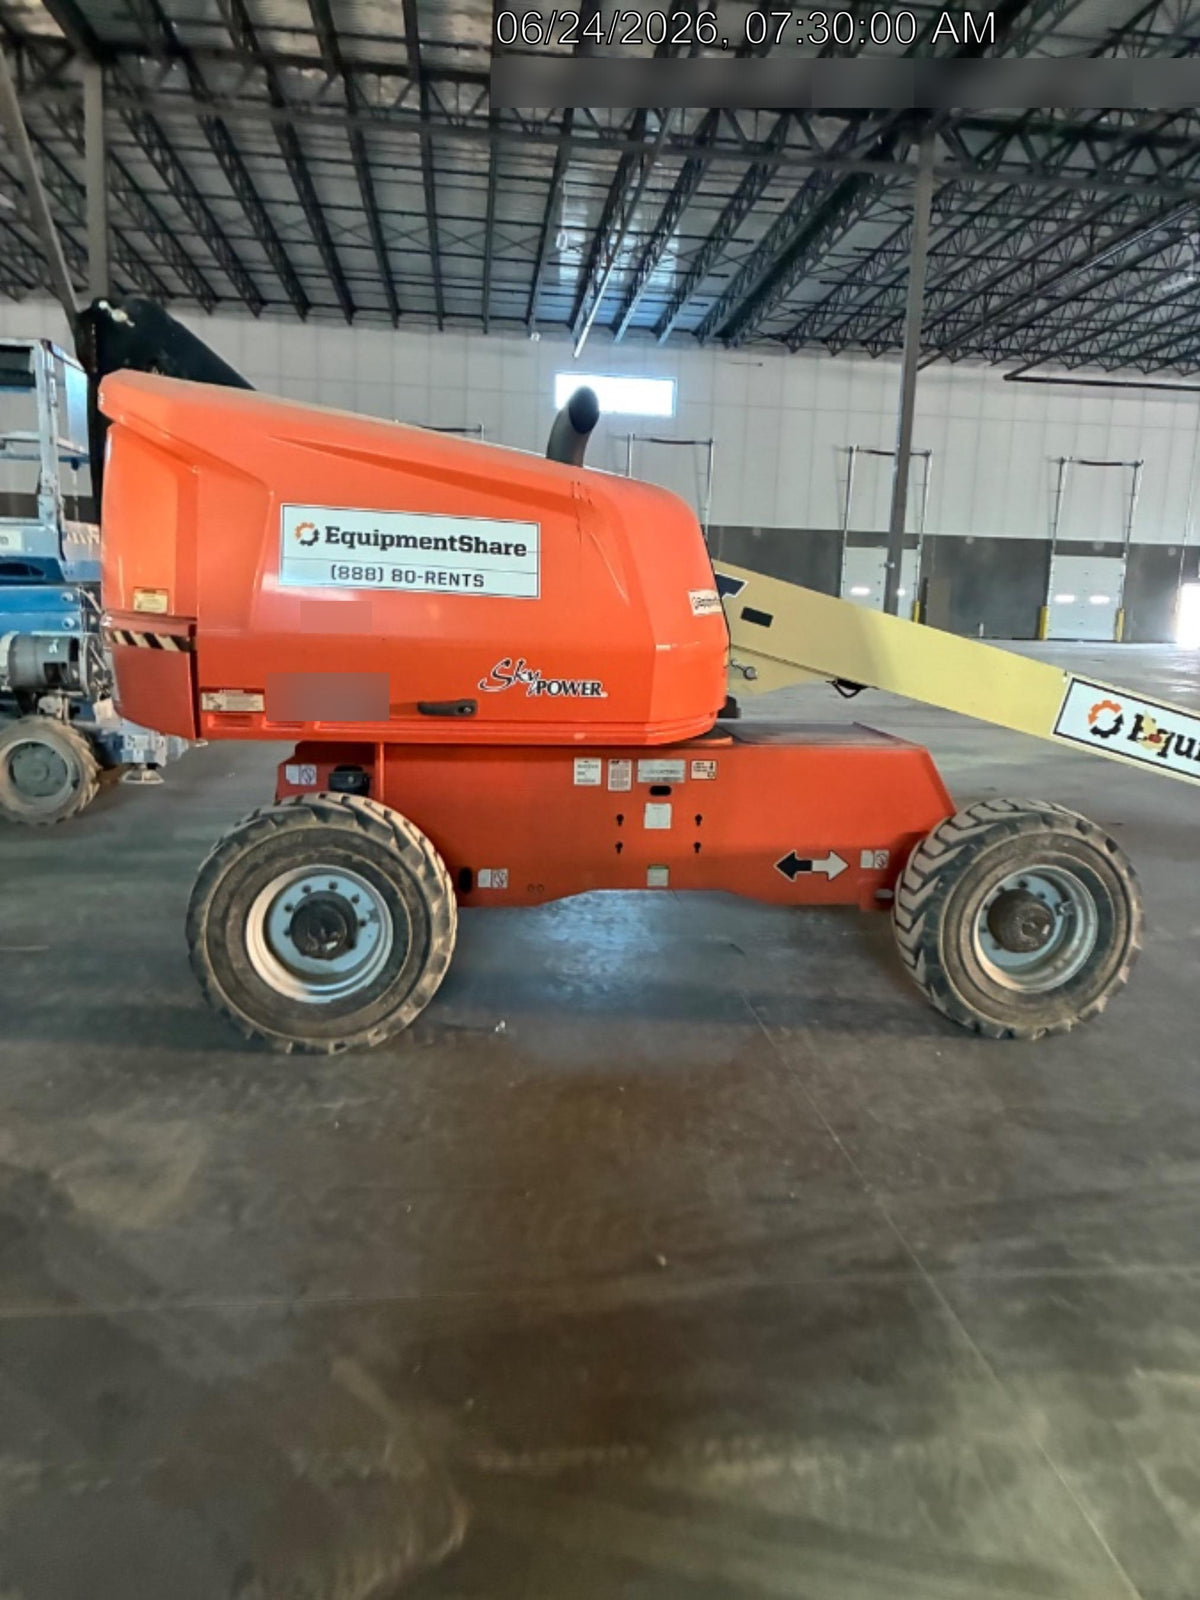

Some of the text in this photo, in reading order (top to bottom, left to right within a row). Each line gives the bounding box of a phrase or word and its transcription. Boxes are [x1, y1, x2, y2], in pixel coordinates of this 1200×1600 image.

[324, 525, 527, 557] EquipmentShare
[331, 564, 485, 588] (888) 80-RENTS
[535, 680, 602, 697] POWER
